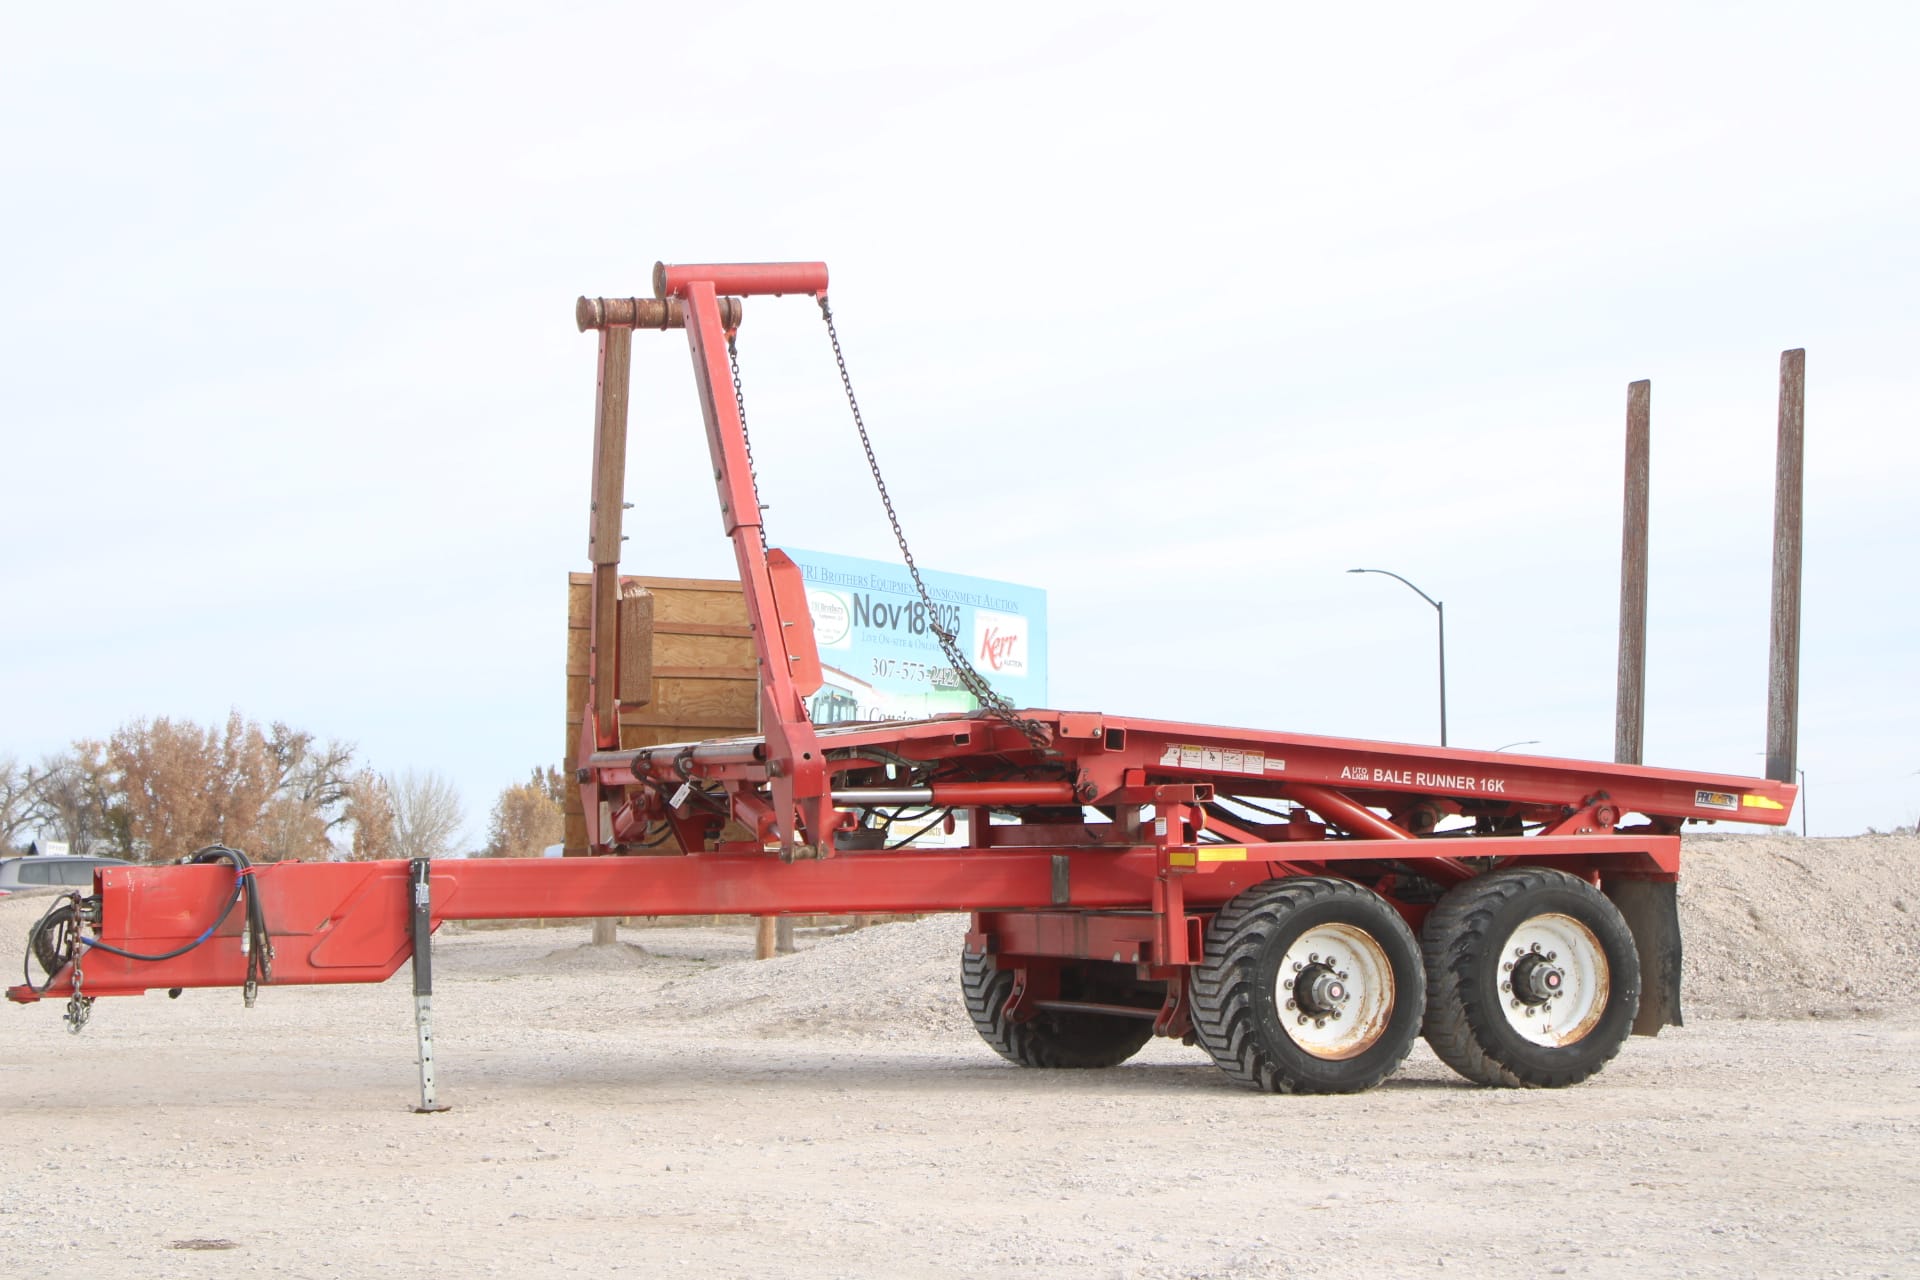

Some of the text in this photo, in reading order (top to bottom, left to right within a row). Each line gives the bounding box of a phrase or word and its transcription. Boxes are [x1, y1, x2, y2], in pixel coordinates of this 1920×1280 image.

[821, 568, 868, 586] BROTHERS
[871, 574, 919, 593] EQUIPMEN
[924, 583, 982, 605] ONSIGNMENT
[984, 593, 1018, 610] AUCTION
[853, 593, 902, 630] Nov
[980, 626, 1017, 671] Kerr
[1373, 768, 1412, 785] BALE
[1416, 772, 1476, 790] RUNNER
[1479, 778, 1505, 793] 16K
